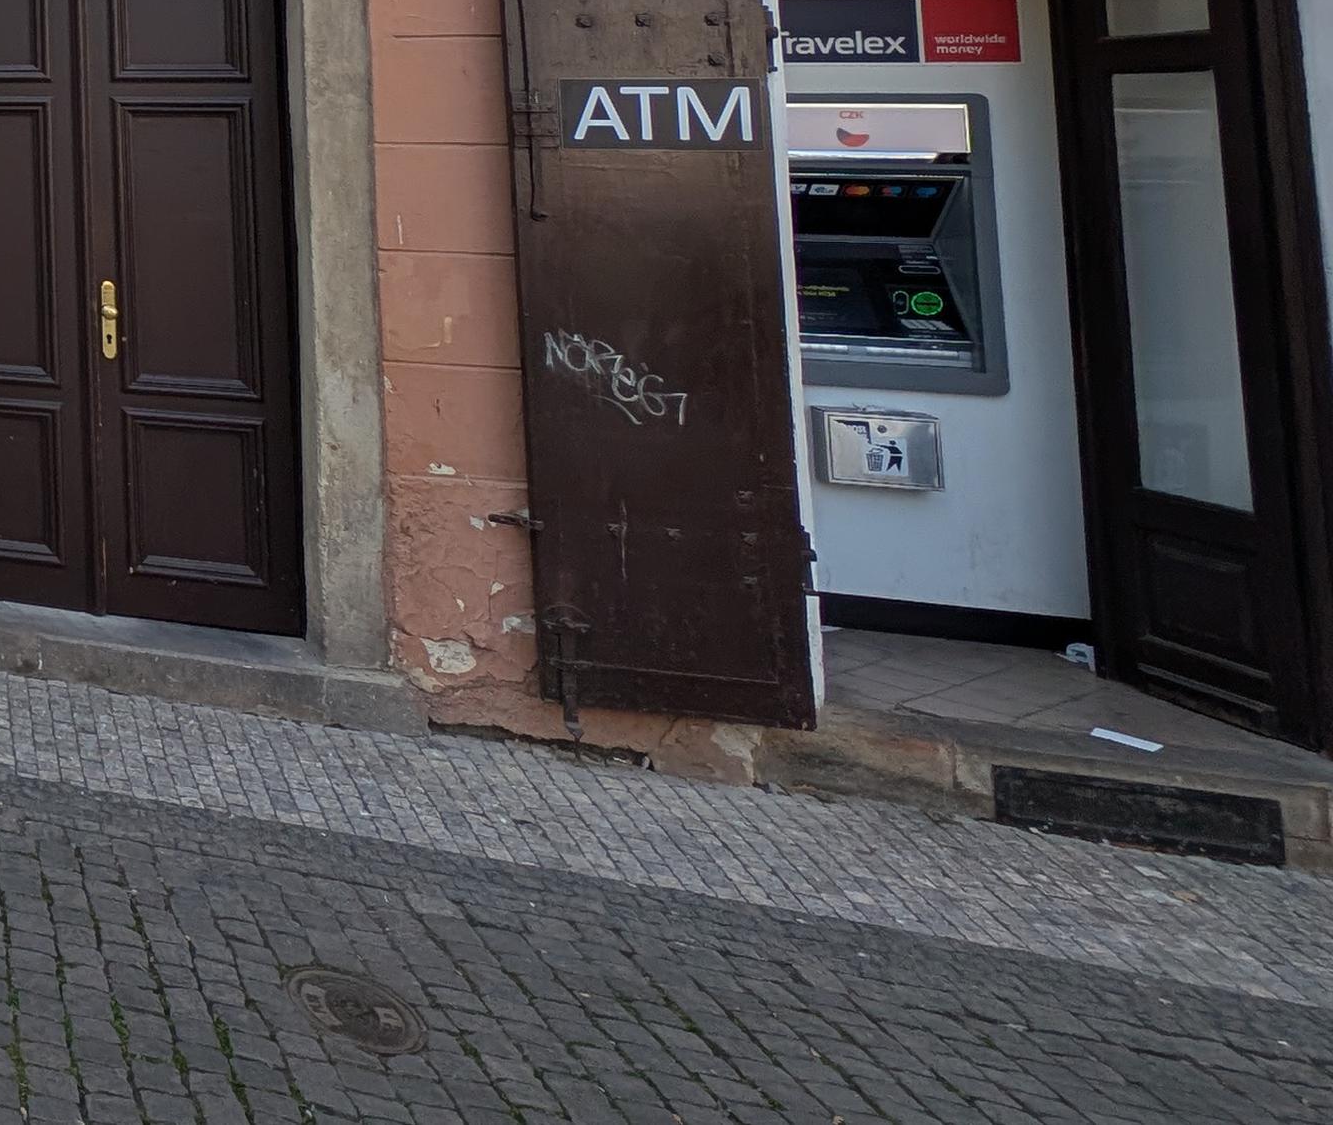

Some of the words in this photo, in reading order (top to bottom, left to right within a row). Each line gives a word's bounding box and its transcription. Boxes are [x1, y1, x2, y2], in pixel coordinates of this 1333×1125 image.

[934, 34, 1007, 45] worldwide
[936, 45, 983, 56] money
[574, 86, 753, 141] ATM
[839, 110, 864, 119] CZK
